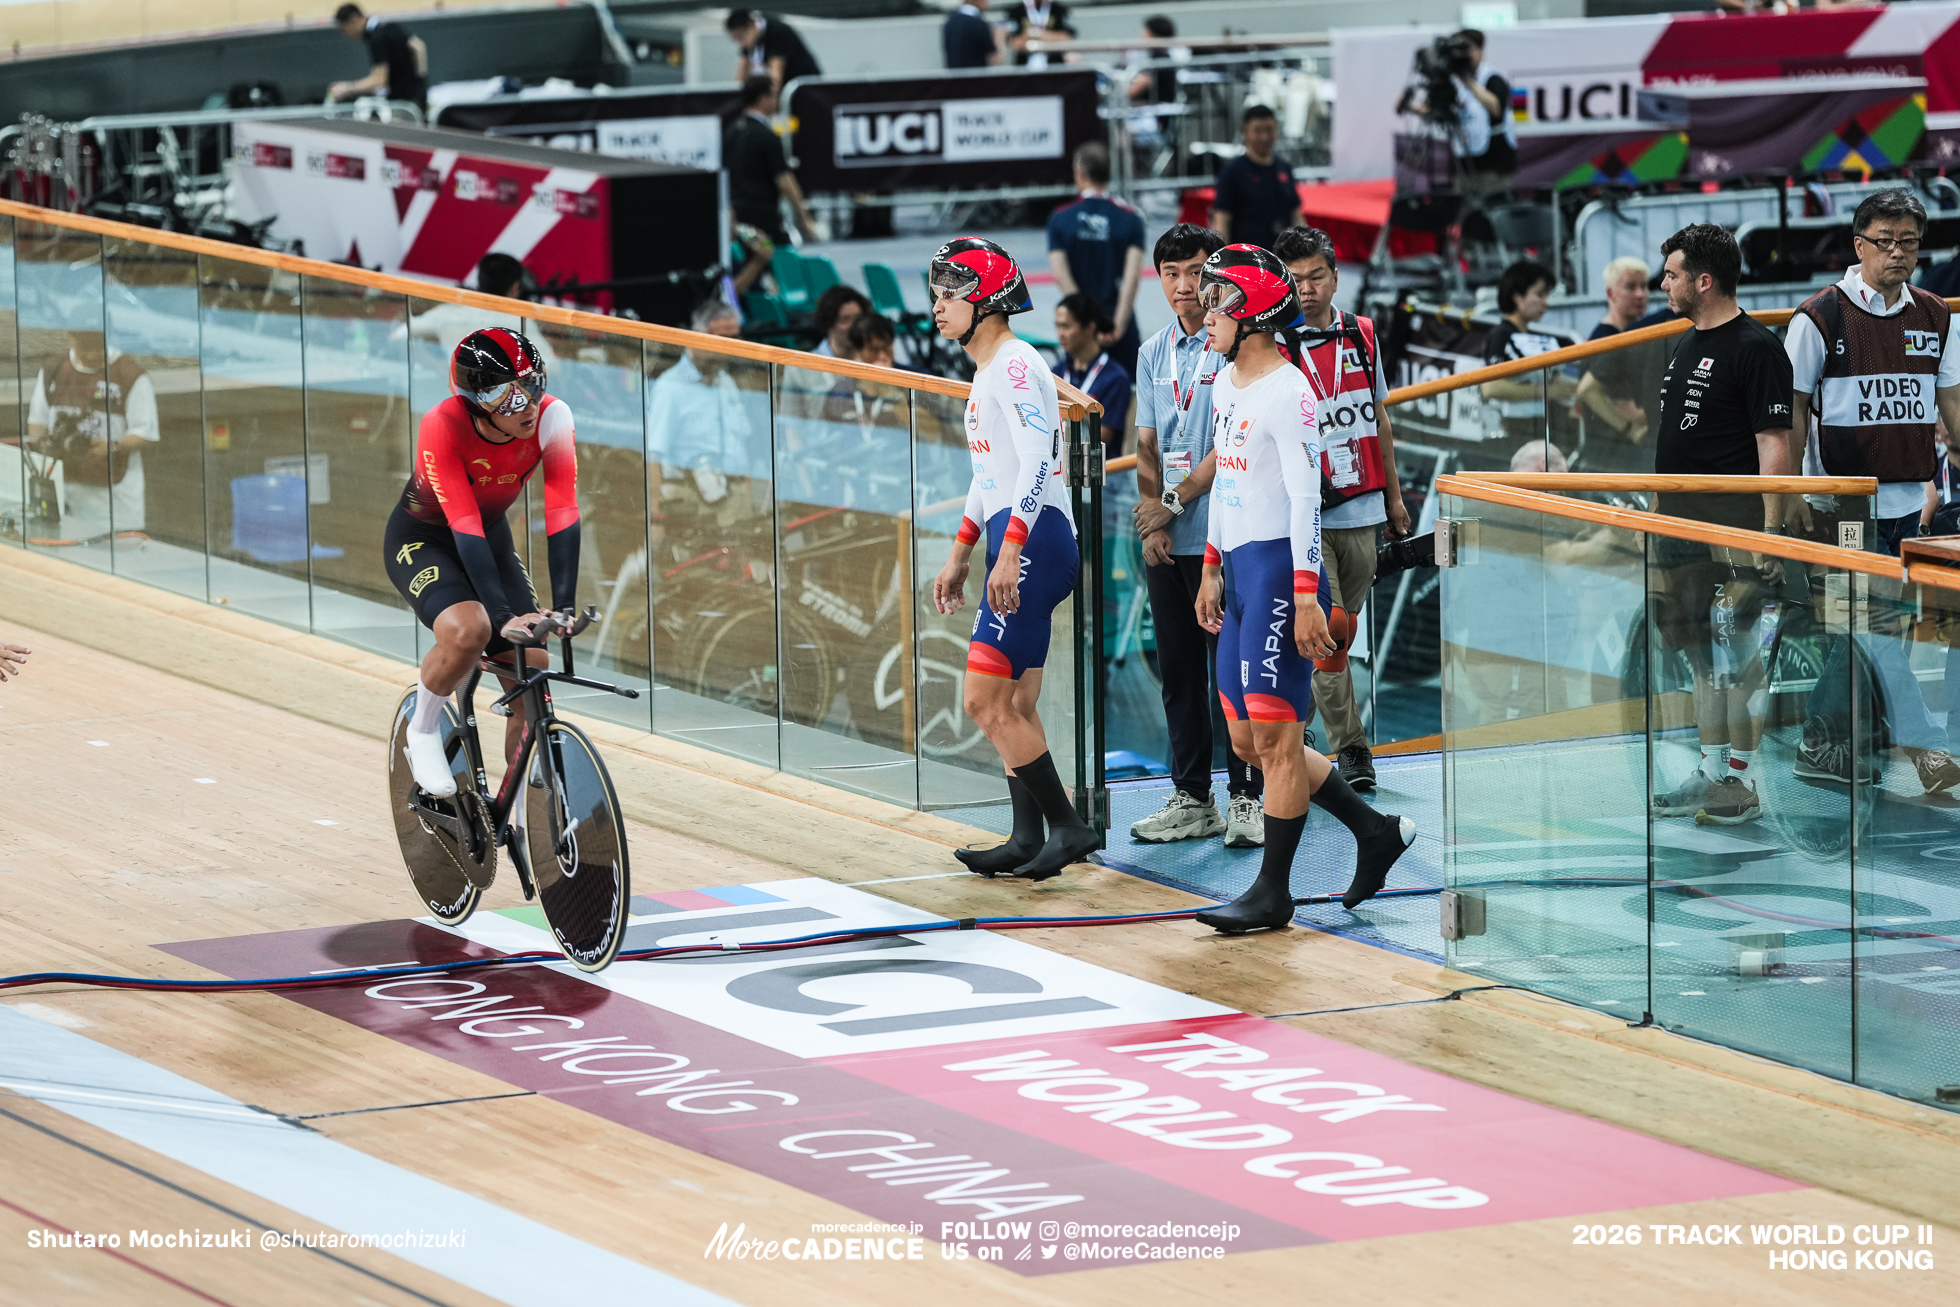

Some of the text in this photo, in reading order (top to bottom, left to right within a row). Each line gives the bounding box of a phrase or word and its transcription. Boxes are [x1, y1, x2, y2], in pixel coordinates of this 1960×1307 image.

[1535, 82, 1631, 122] UCI
[857, 112, 939, 155] UCI
[990, 276, 1021, 302] Kabuto
[1255, 293, 1293, 323] Kabuto
[1836, 339, 1845, 355] 5
[1912, 334, 1940, 353] UC
[1858, 378, 1921, 399] VIDEO
[1858, 400, 1925, 422] RADIO
[1301, 442, 1315, 468] KEIRIN
[423, 450, 449, 503] CHINA
[1031, 461, 1049, 497] Cyclers
[1312, 507, 1320, 544] Cyclers
[1844, 527, 1857, 541] 拉
[1714, 583, 1731, 647] JAPAN
[1260, 598, 1289, 688] JAPAN
[1107, 1032, 1447, 1123] TRACK
[511, 1036, 799, 1115] KONG
[779, 1129, 1085, 1221] CHINA
[942, 1048, 1490, 1210] WORLD CUP
